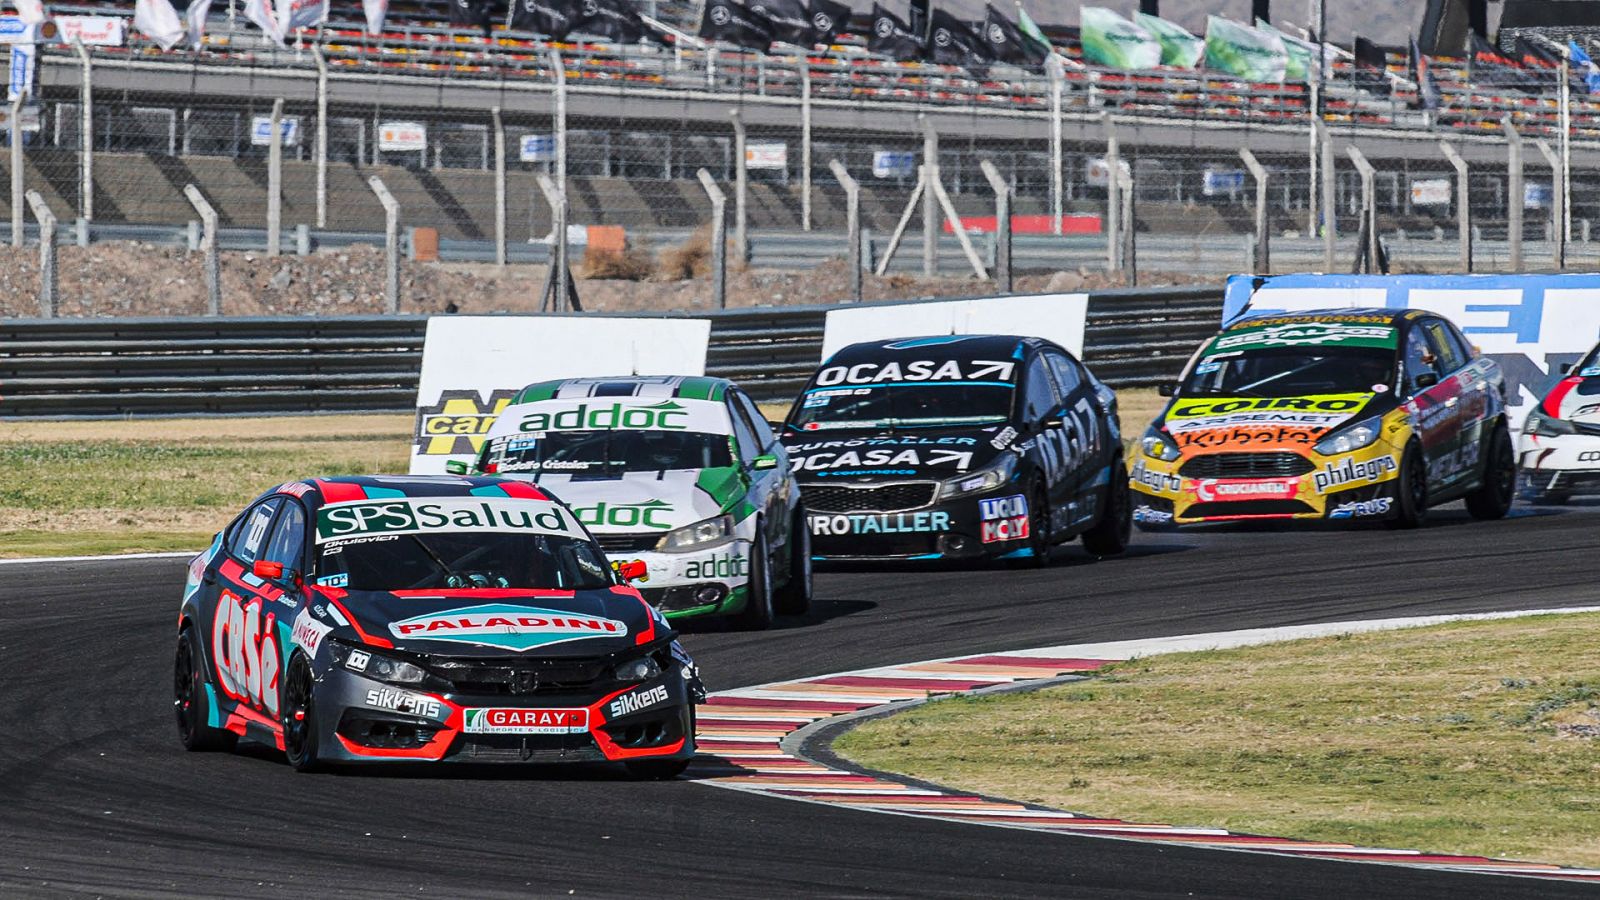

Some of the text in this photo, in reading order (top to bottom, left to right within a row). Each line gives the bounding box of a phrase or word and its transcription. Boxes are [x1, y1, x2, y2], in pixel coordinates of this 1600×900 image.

[1219, 328, 1391, 346] METALFOR
[816, 359, 963, 386] OCASA
[519, 403, 689, 431] addoc
[1175, 399, 1360, 416] COIRO
[1180, 413, 1340, 429] ARSEMET
[784, 437, 977, 453] EUROTALLER
[1185, 428, 1309, 448] Kubota
[497, 460, 540, 472] Rodolfo
[1315, 456, 1396, 492] philagro
[325, 502, 570, 535] SPS Salud
[982, 497, 1024, 520] LIQUI
[983, 517, 1026, 541] MOLY
[323, 546, 343, 556] C3
[324, 535, 399, 549] Okulovich
[686, 553, 750, 579] addoc
[398, 616, 618, 635] PALADINI
[366, 688, 441, 718] sikkens
[610, 684, 669, 718] sikkens
[493, 712, 566, 725] GARAY
